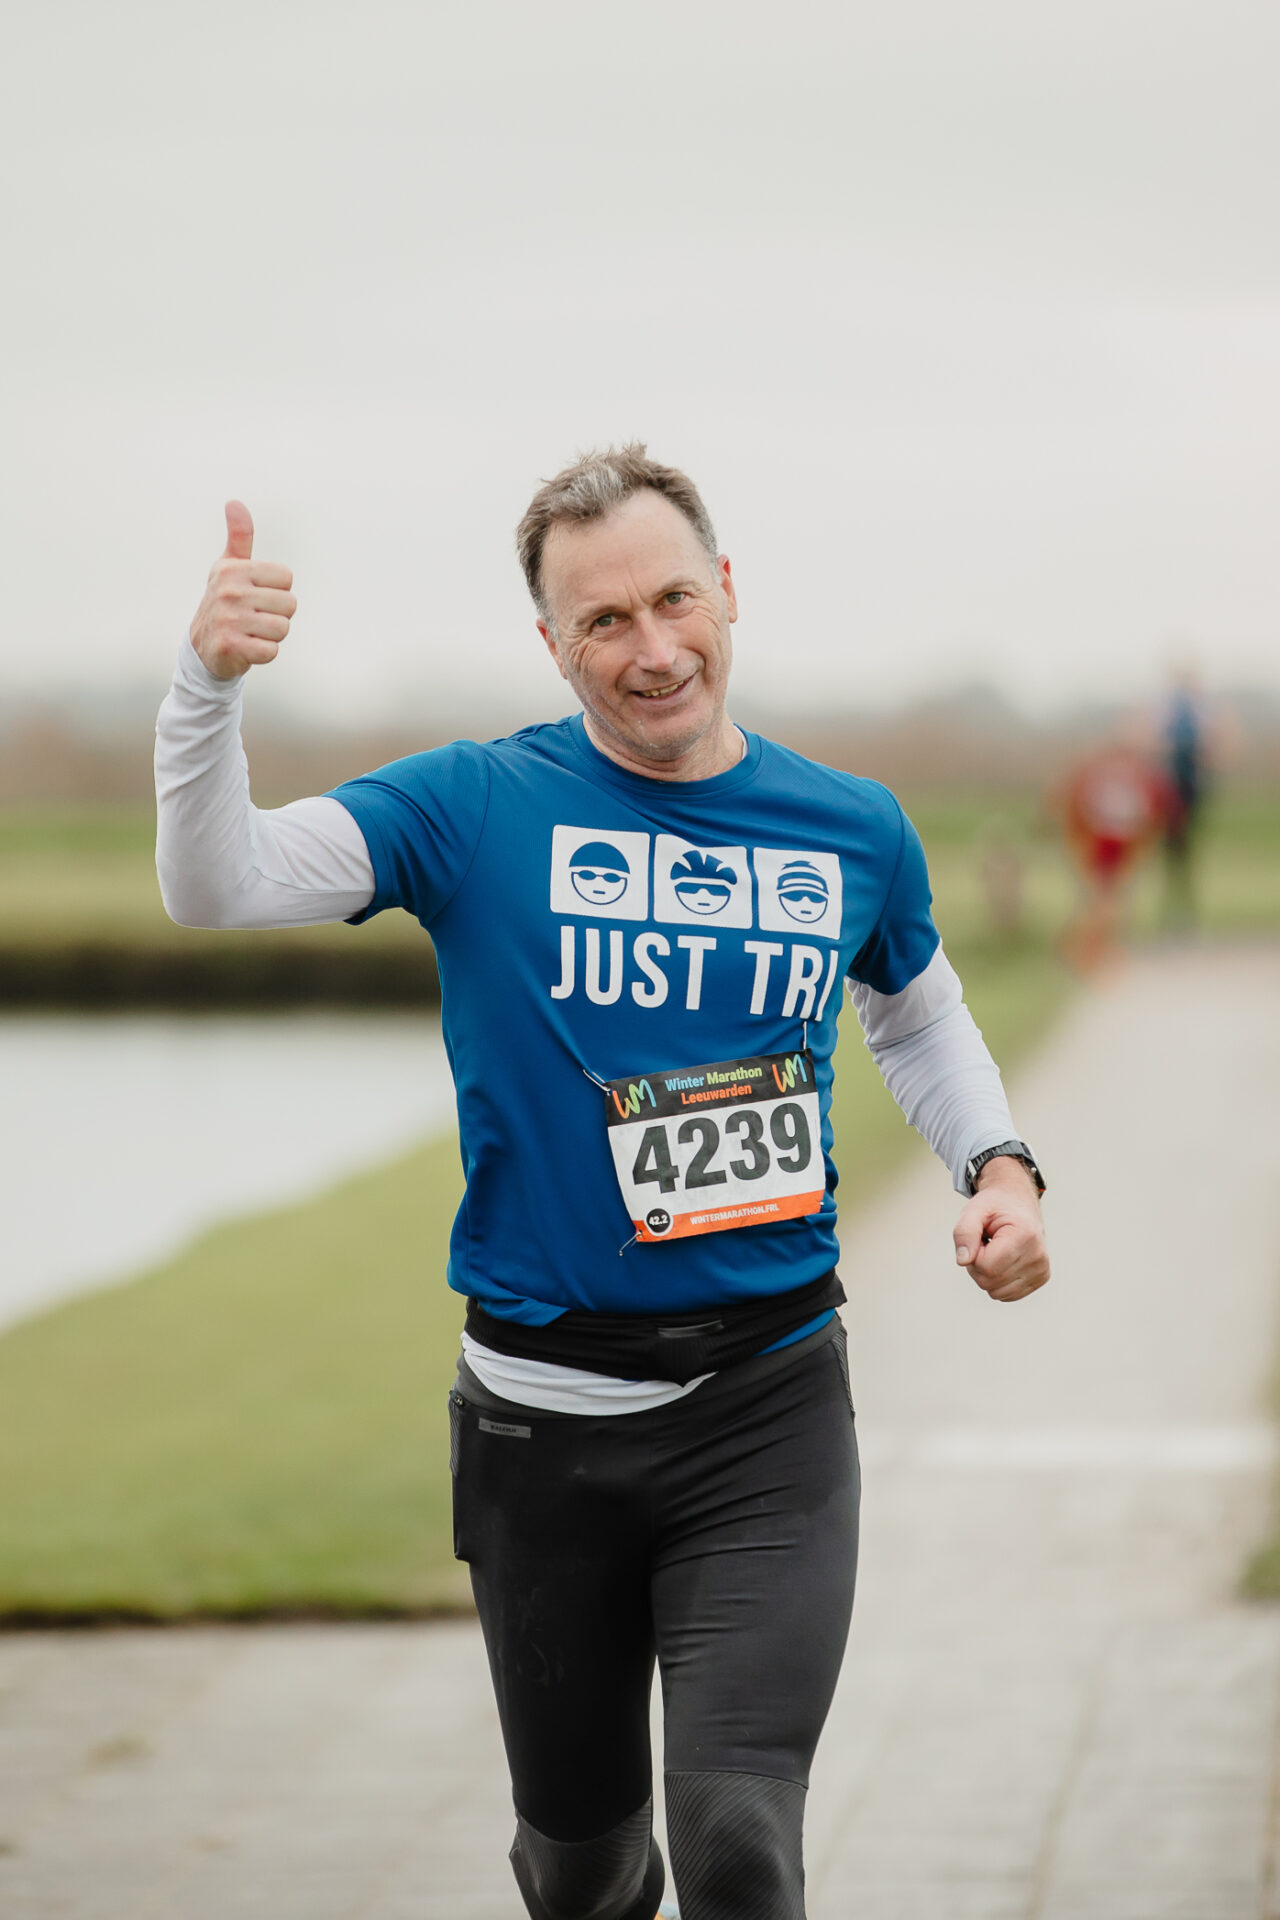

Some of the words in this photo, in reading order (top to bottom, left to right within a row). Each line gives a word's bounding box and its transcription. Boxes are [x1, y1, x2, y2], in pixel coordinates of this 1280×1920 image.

[550, 925, 717, 1010] JUST
[744, 940, 839, 1022] TRI
[665, 1075, 704, 1092] Winter
[706, 1066, 762, 1084] Marathon
[681, 1084, 752, 1105] Leeuwarden
[632, 1102, 812, 1194] 4239
[648, 1214, 668, 1225] 42.2
[690, 1204, 780, 1225] WINTERMARATHON.FRL
